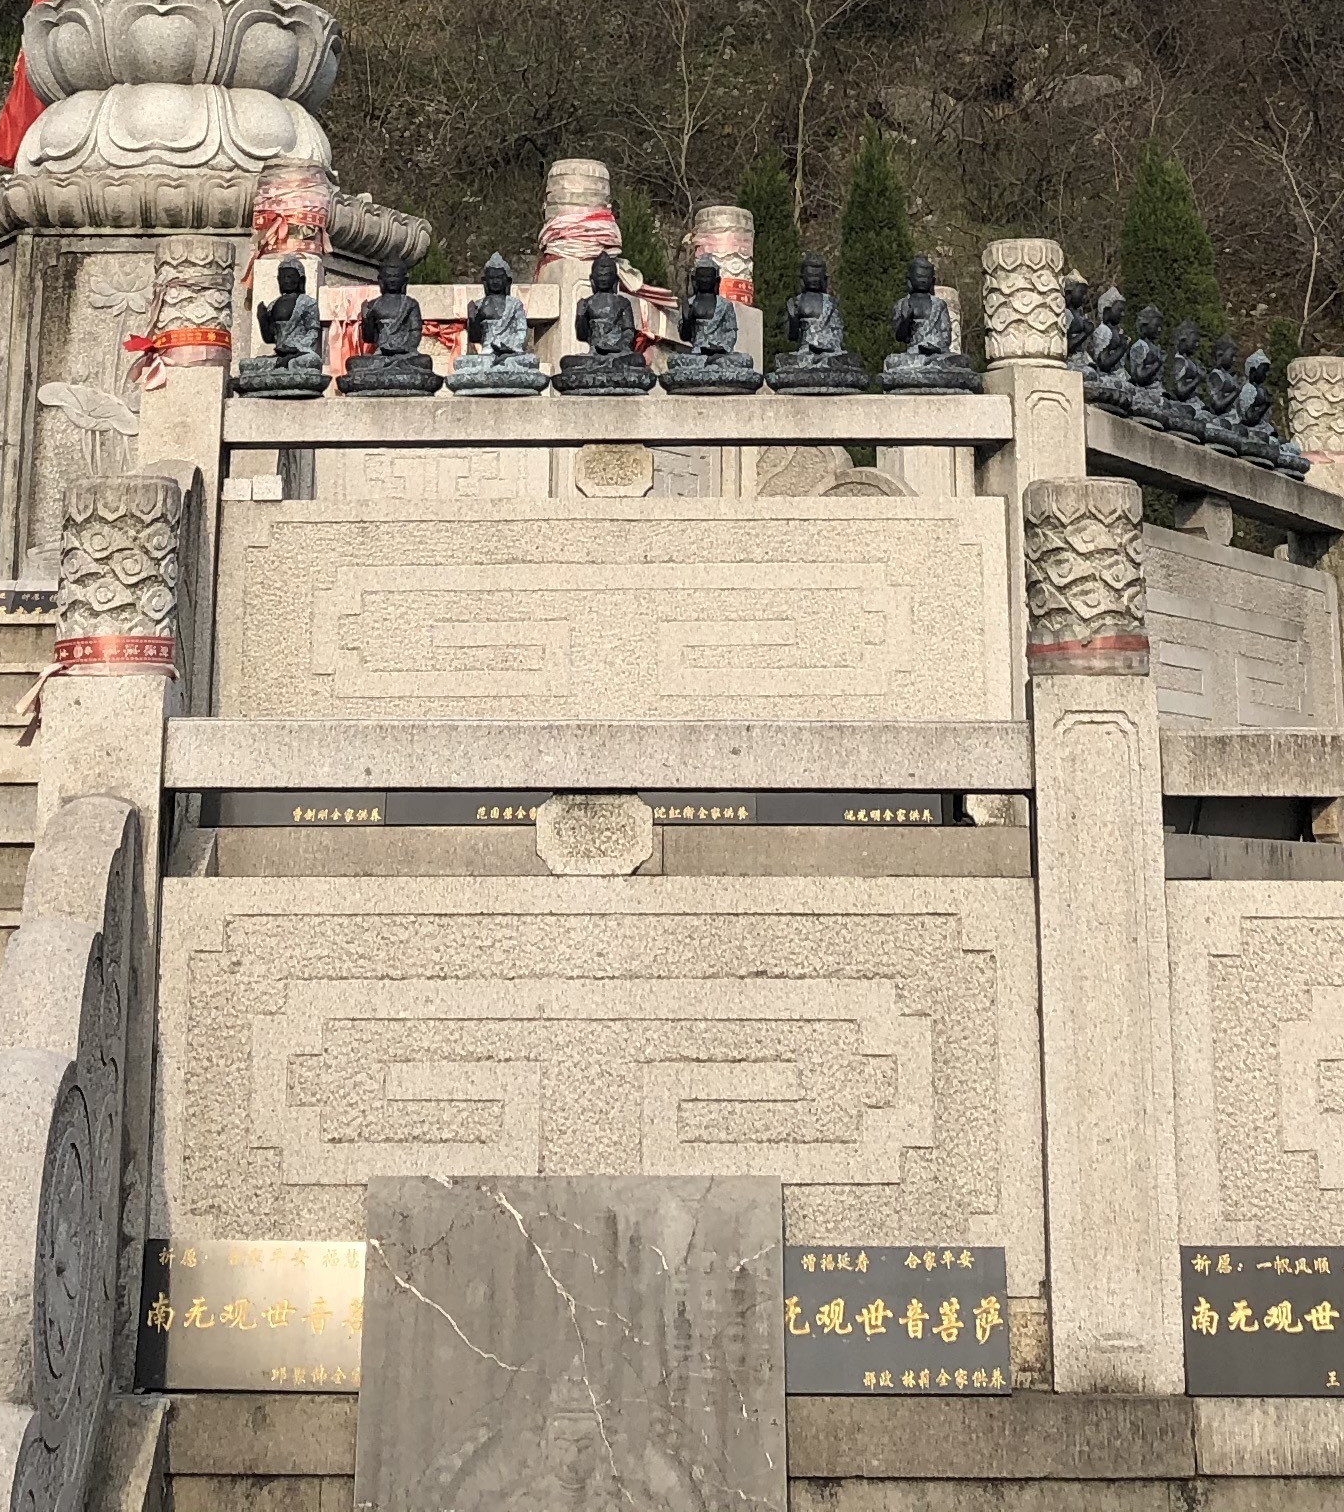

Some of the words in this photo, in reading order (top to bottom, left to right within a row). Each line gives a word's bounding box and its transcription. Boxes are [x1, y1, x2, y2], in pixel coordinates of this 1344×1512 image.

[785, 1295, 1004, 1346] 无观世音菩萨
